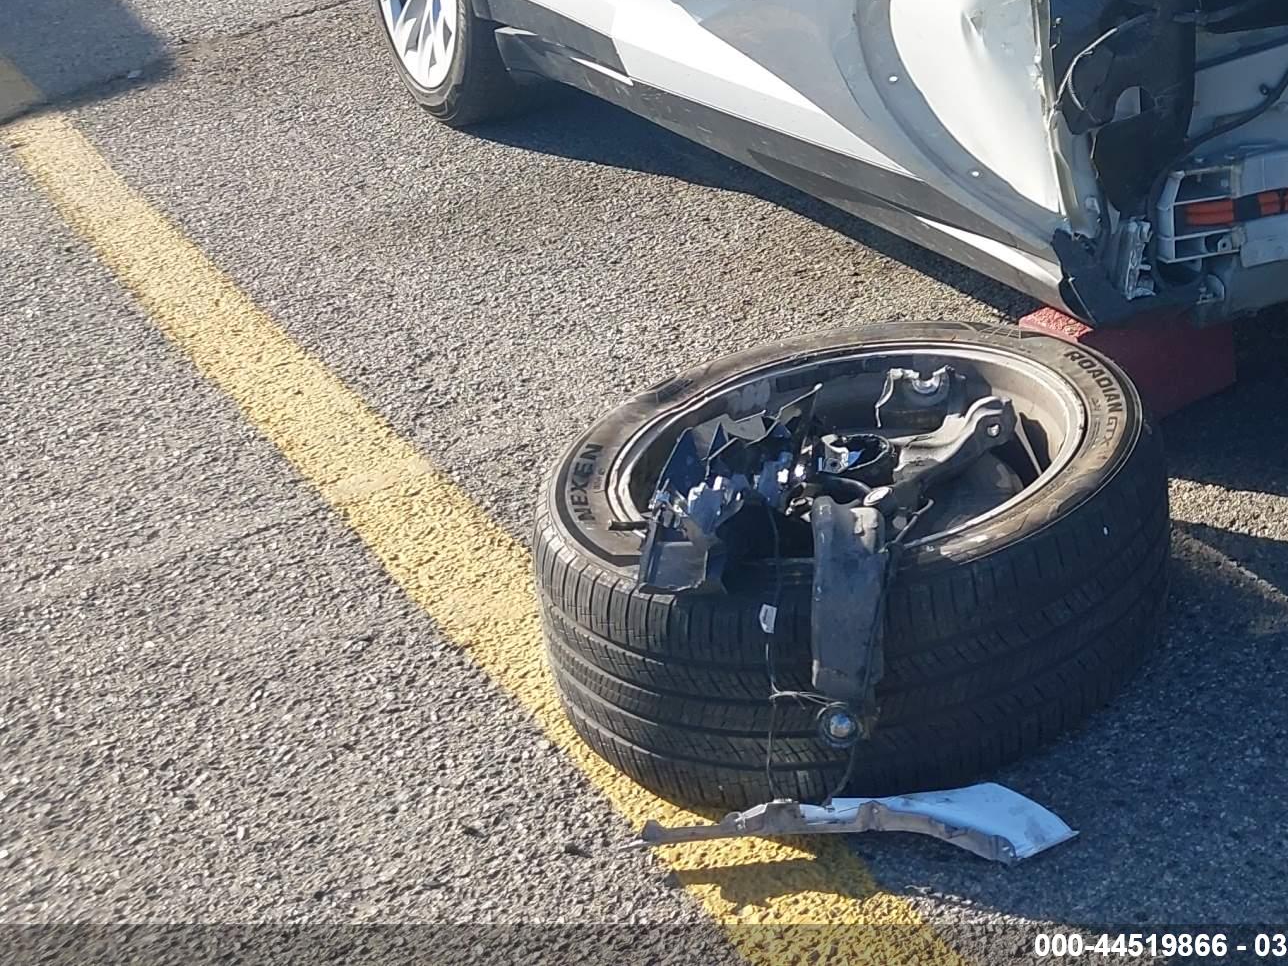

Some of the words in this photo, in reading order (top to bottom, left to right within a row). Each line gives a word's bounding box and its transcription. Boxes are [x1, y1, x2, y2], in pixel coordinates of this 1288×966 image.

[1063, 349, 1124, 413] ROADIAN
[1099, 416, 1118, 447] GTX
[570, 443, 604, 522] NEXEN
